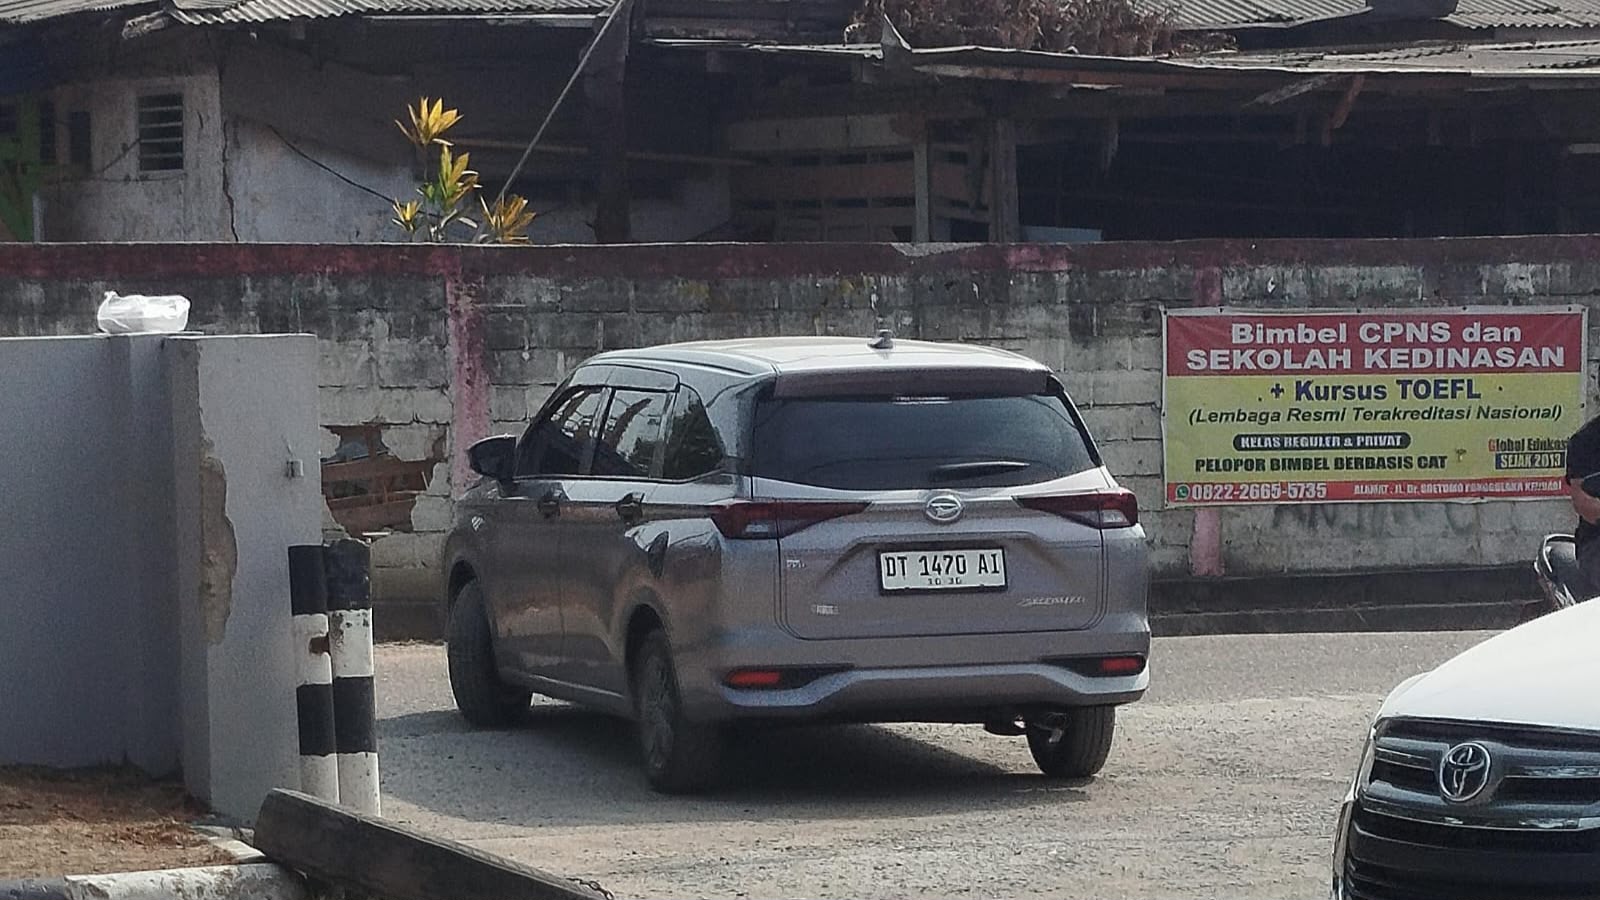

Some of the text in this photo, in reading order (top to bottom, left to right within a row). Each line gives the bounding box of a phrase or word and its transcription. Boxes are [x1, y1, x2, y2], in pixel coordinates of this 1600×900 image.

[1231, 321, 1522, 345] Bimbel CPNS dan
[1186, 346, 1565, 371] SEKOLAH KEDINASAN
[1295, 379, 1388, 401] Kursus
[1396, 378, 1482, 400] TOEFL
[1189, 405, 1562, 425] (Lembaga Resmi Terakreditasi Nasional)
[1240, 436, 1281, 449] KELAS
[1283, 436, 1341, 448] REGULER
[1356, 434, 1403, 447] PRIVAT
[1195, 454, 1448, 473] PELOPOR BIMBEL BERBASIS CAT
[1500, 453, 1561, 468] SEJAK 2013
[1191, 482, 1328, 500] 0822-2665-5735
[885, 553, 1000, 577] DT 1470 AI
